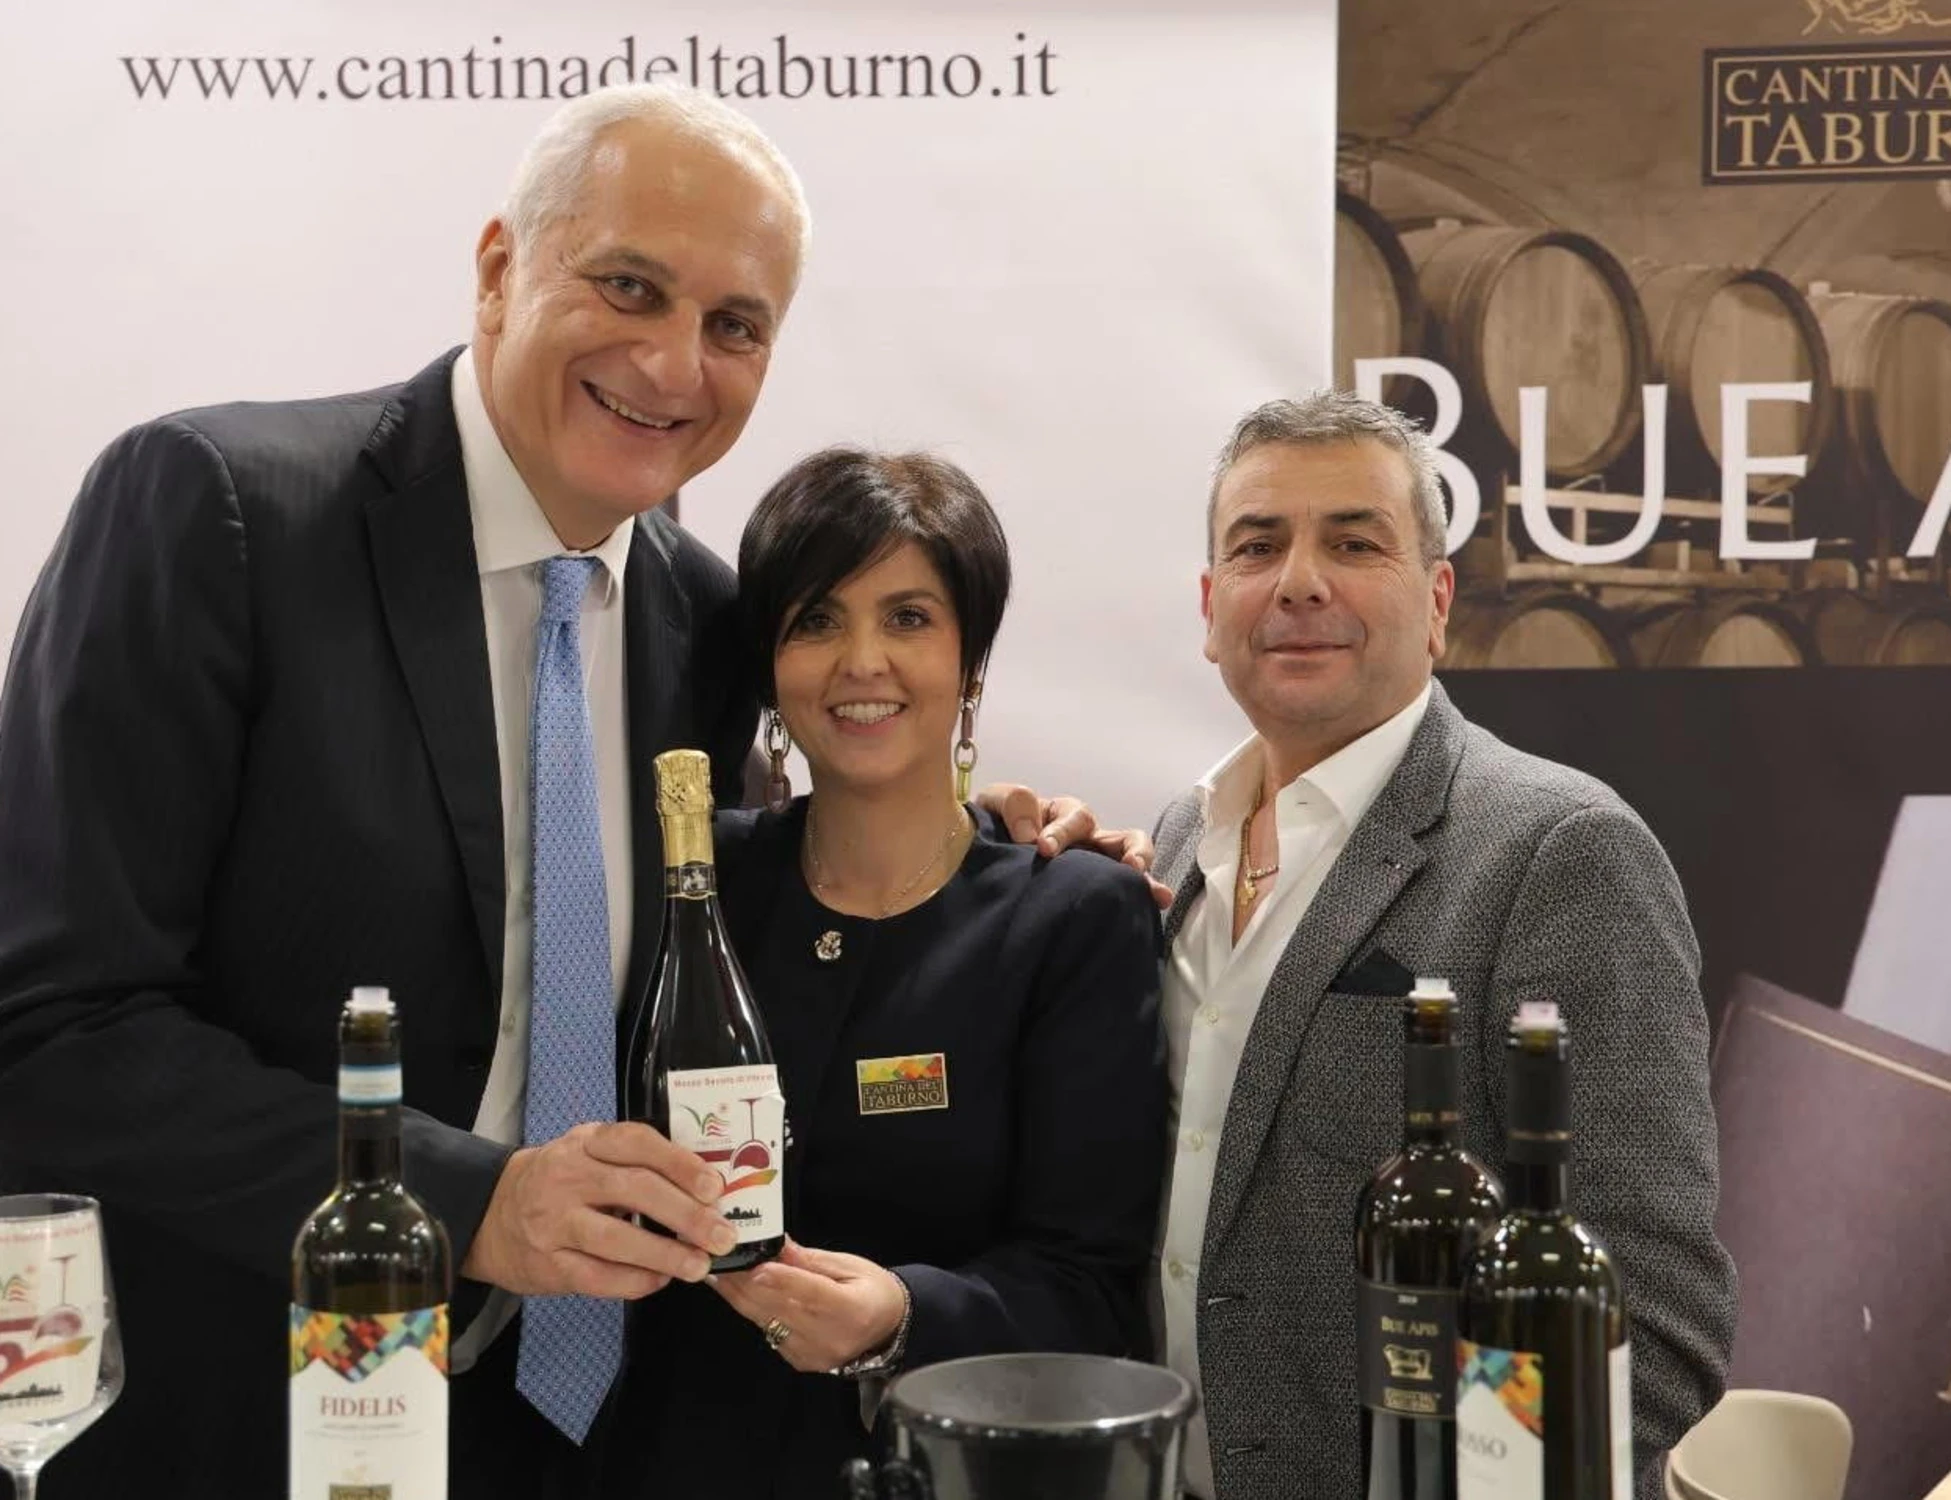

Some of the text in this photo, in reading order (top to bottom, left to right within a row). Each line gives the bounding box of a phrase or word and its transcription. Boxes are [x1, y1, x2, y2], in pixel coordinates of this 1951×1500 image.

[119, 32, 1060, 102] www.cantinadeltaburno.it
[1724, 63, 1951, 106] CANTINA
[1353, 356, 1817, 565] BUE
[864, 1083, 915, 1096] CANTINA
[867, 1090, 941, 1108] TABURNO
[319, 1394, 407, 1417] FIDELIS
